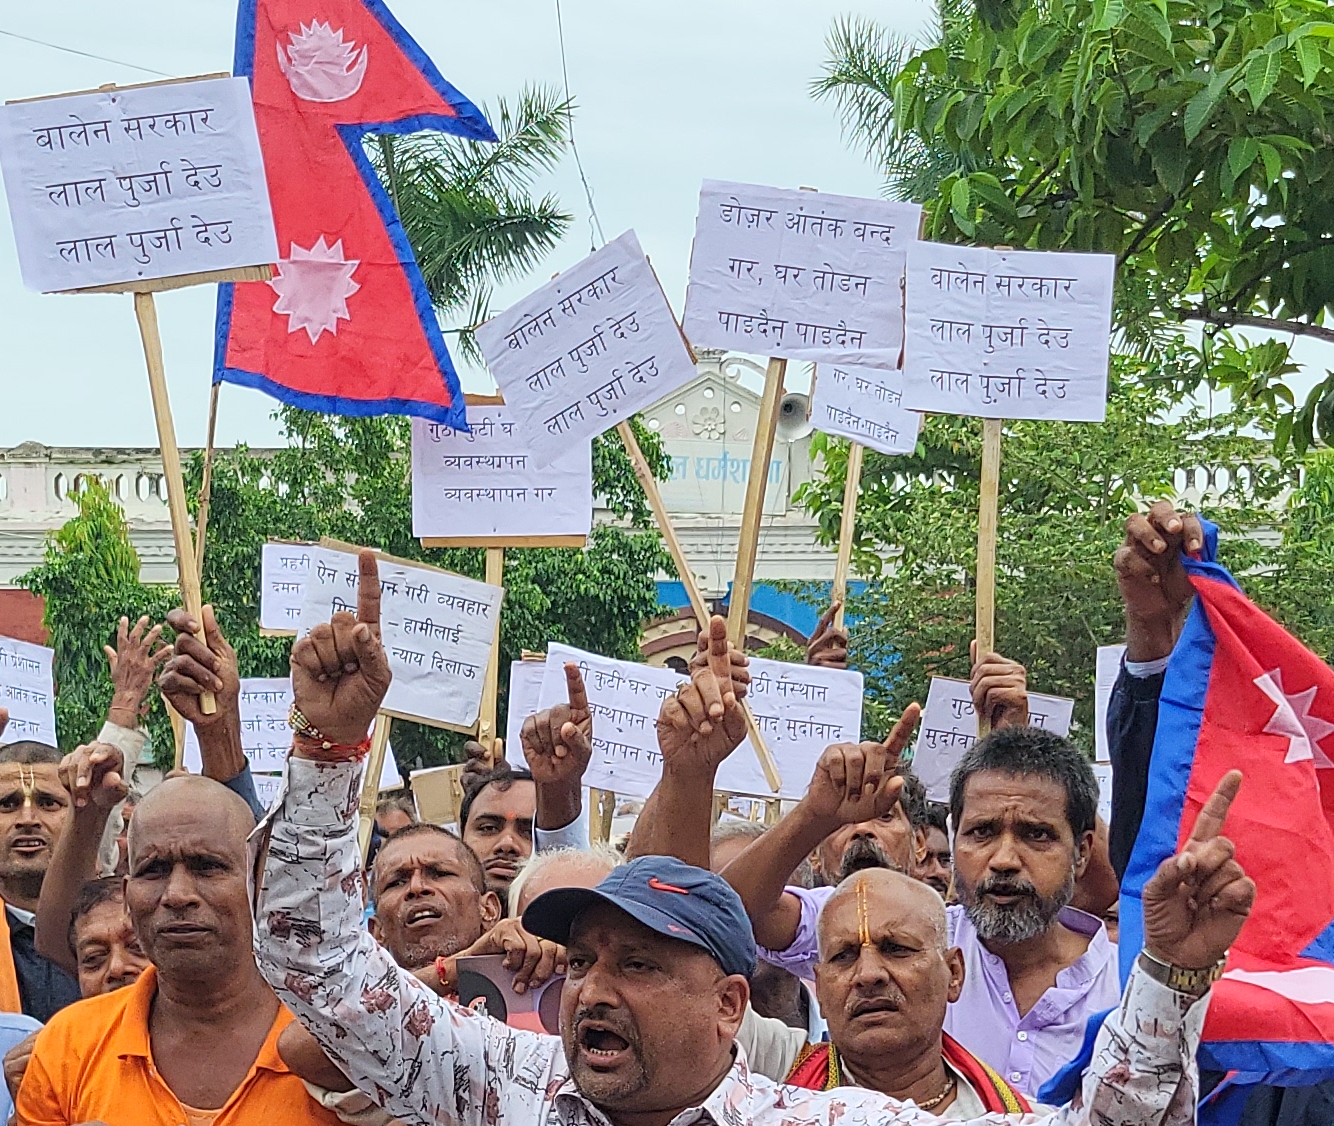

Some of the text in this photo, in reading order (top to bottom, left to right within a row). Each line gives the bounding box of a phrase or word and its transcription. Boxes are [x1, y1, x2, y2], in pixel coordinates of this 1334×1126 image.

[32, 108, 219, 150] बालेन सरकार
[45, 158, 223, 208] लाल पुर्जा देउ
[56, 215, 233, 266] लाल पुर्जा देउ
[853, 221, 896, 246] बन्द
[728, 258, 873, 296] गर, घर तोडन
[930, 261, 988, 295] बालेन
[503, 307, 557, 351] बालेन
[795, 319, 868, 349] पाइदैन
[929, 317, 1073, 354] लाल पुर्जा देउ
[525, 311, 640, 393] लाल पुर्जा देउ
[543, 356, 659, 437] लाल पुर्जा देउ
[929, 369, 973, 394] लाल
[1033, 368, 1071, 399] देउ
[443, 455, 528, 470] व्यवस्थापन
[444, 487, 557, 502] व्यवस्थापन गर
[280, 555, 310, 570] प्रहरी
[271, 582, 301, 595] दमन
[317, 564, 492, 619] ऐन गरी व्यवहार
[403, 614, 464, 643] हामीलाई
[392, 647, 481, 680] न्याय दिलाऊ
[629, 679, 651, 698] घर
[925, 727, 976, 749] मुर्दावा
